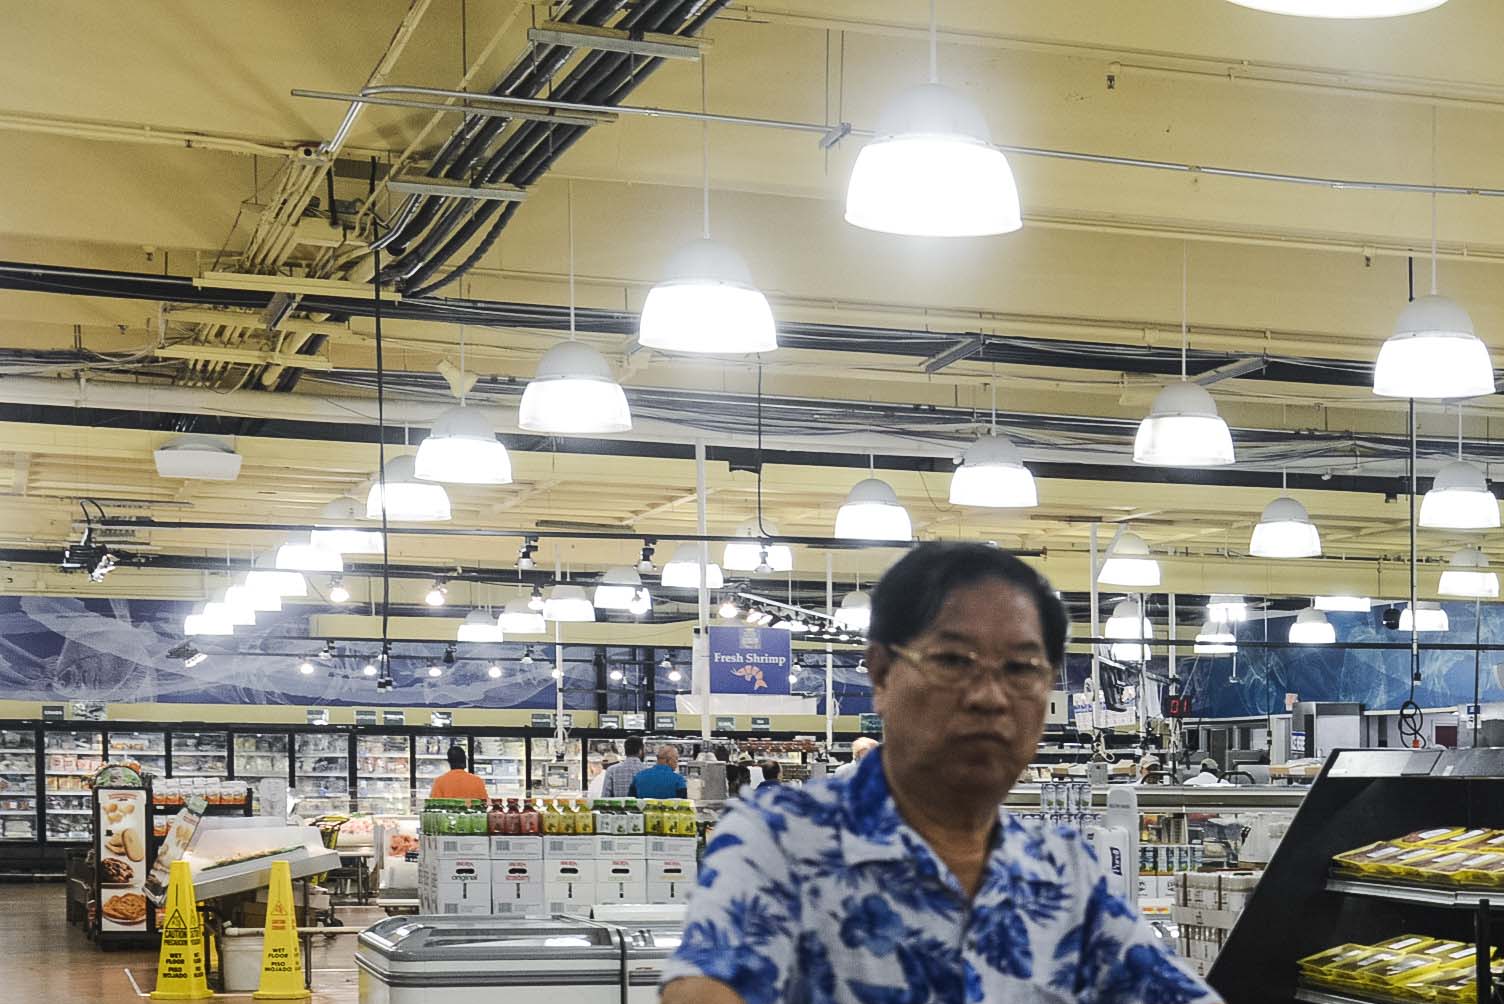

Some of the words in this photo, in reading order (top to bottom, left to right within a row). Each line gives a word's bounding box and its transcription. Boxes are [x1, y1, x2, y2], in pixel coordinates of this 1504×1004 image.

[714, 652, 743, 663] Fresh
[746, 652, 786, 666] Shrimp
[451, 873, 478, 882] original
